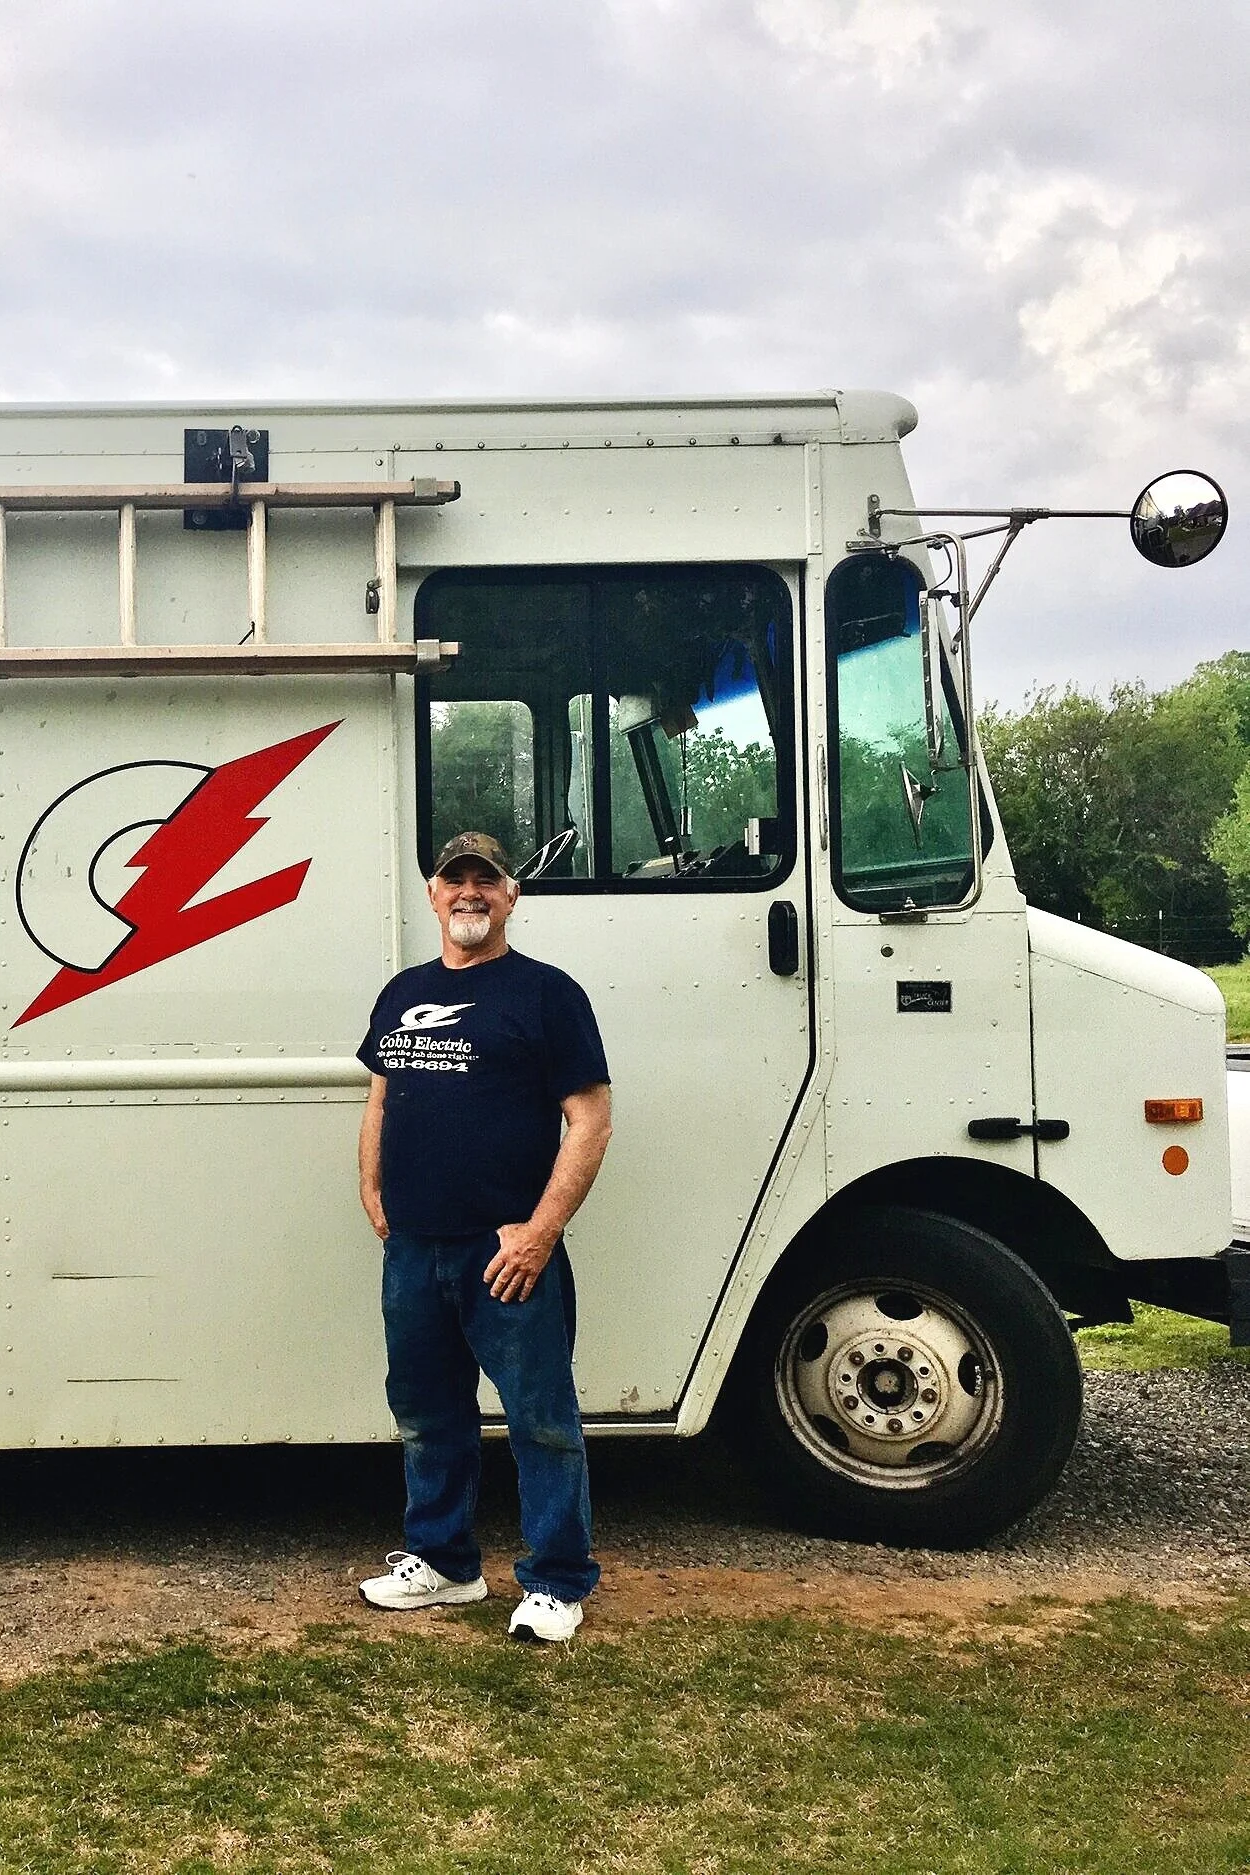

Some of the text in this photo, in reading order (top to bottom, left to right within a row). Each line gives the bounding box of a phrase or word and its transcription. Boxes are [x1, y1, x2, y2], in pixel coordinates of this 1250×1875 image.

[379, 1033, 472, 1053] Cobb Electric
[411, 1050, 426, 1059] job
[426, 1051, 447, 1059] done
